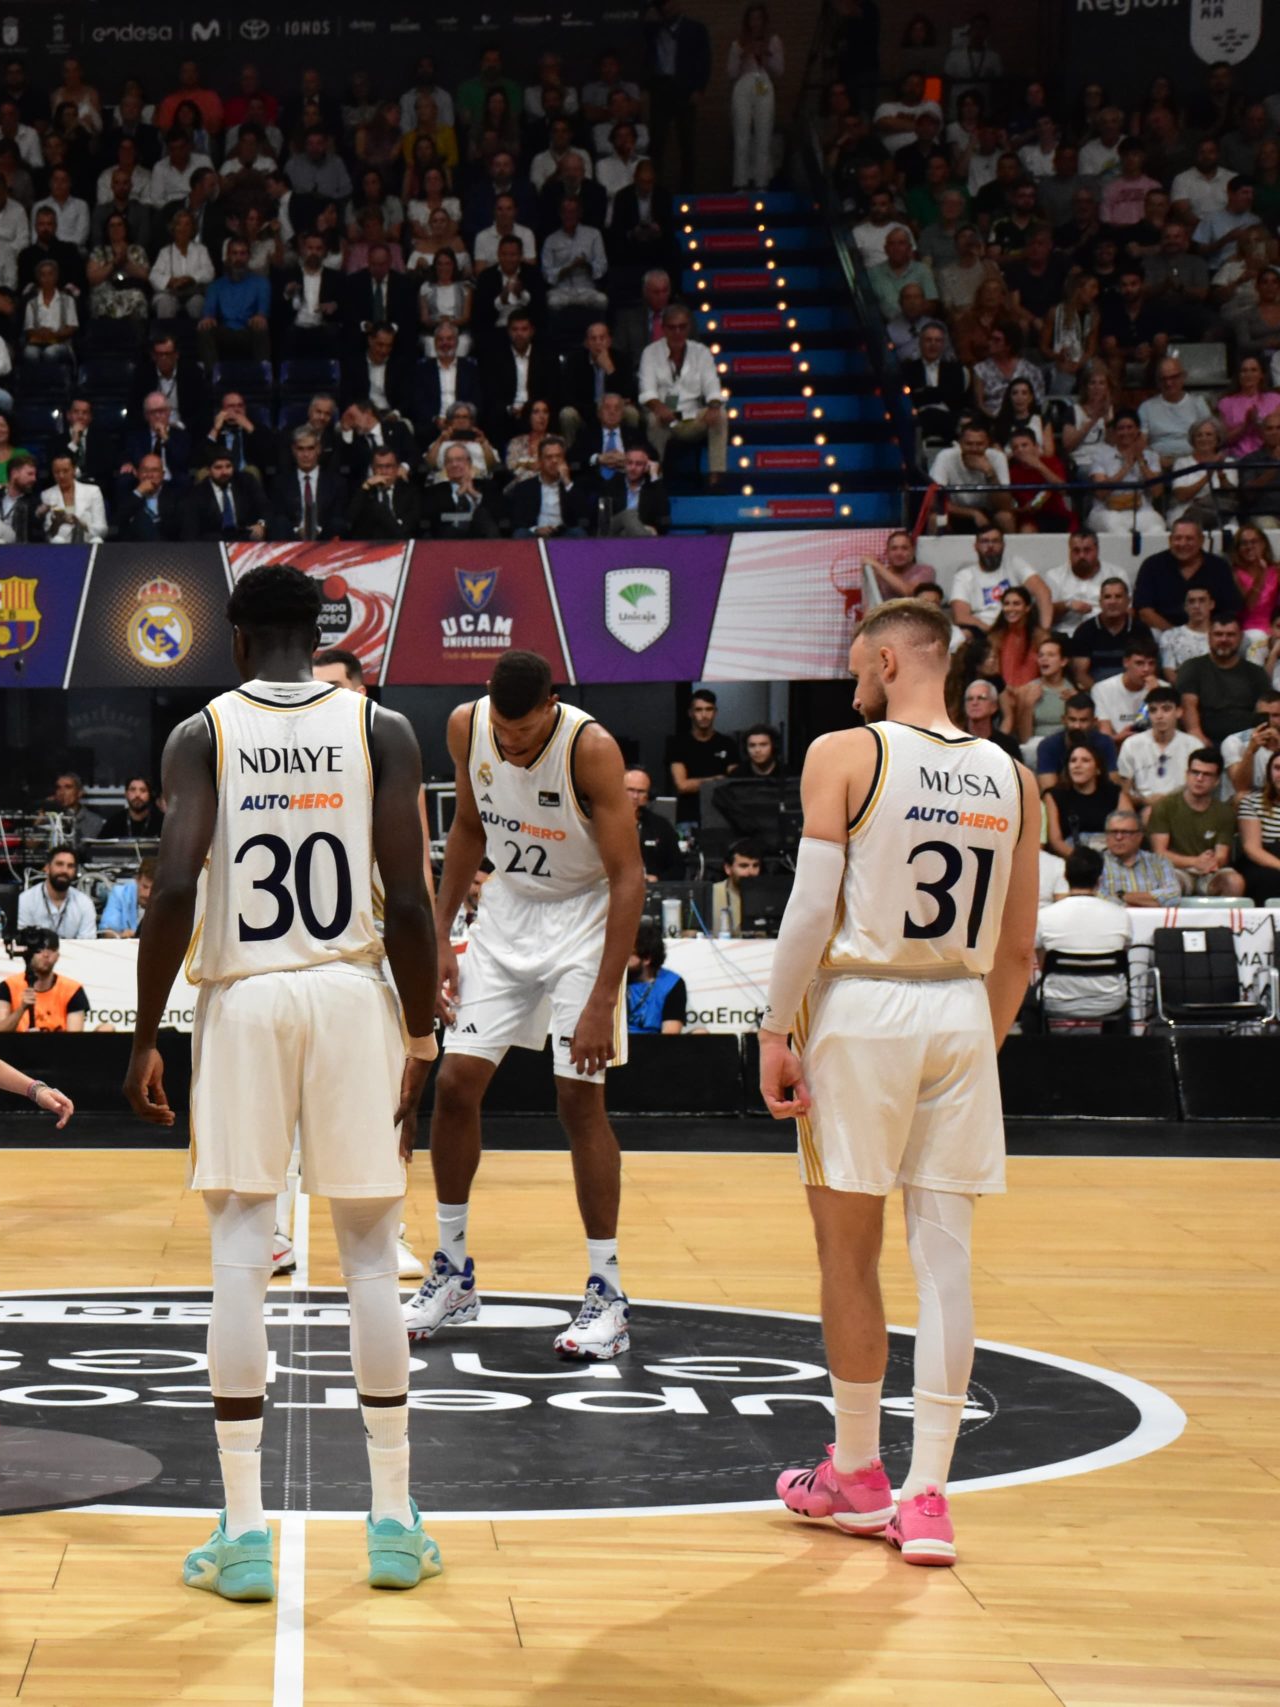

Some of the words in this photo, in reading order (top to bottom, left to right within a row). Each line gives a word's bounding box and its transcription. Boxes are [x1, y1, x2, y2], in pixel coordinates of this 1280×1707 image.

[91, 22, 173, 43] endesa
[440, 614, 514, 637] UCAM
[618, 610, 657, 623] Unicaja
[442, 636, 512, 648] UNIVERSIDAD
[238, 746, 343, 774] NDIAYE
[920, 766, 1001, 799] MUSA
[240, 793, 344, 811] AUTOHERO
[480, 811, 566, 841] AUTOHERO
[905, 806, 1009, 833] AUTOHERO
[504, 840, 551, 877] 22
[234, 832, 352, 942] 30
[903, 840, 995, 949] 31
